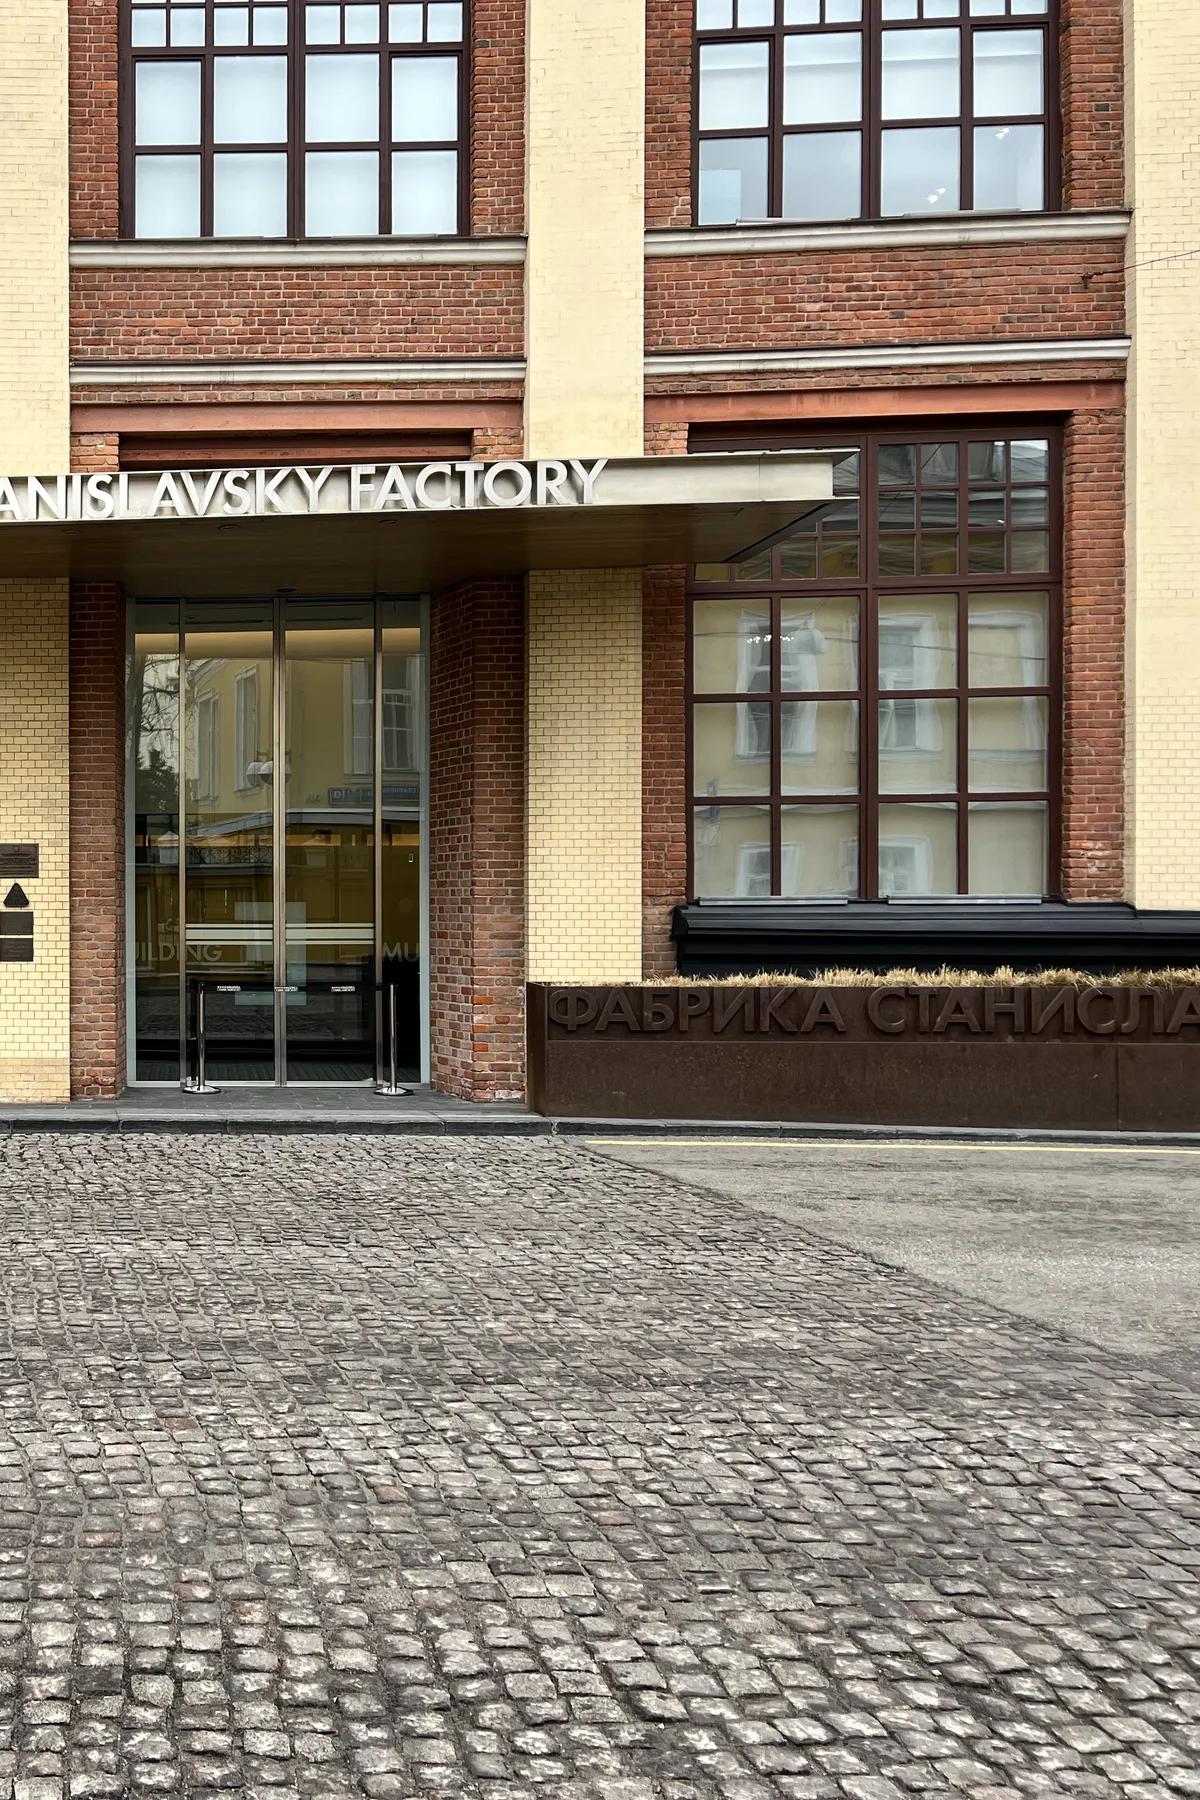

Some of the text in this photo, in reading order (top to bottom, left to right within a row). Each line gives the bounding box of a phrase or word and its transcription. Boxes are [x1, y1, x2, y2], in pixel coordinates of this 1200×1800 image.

[350, 459, 609, 511] FACTORY
[136, 942, 222, 962] ILDING
[549, 986, 847, 1032] ФАБРИКА
